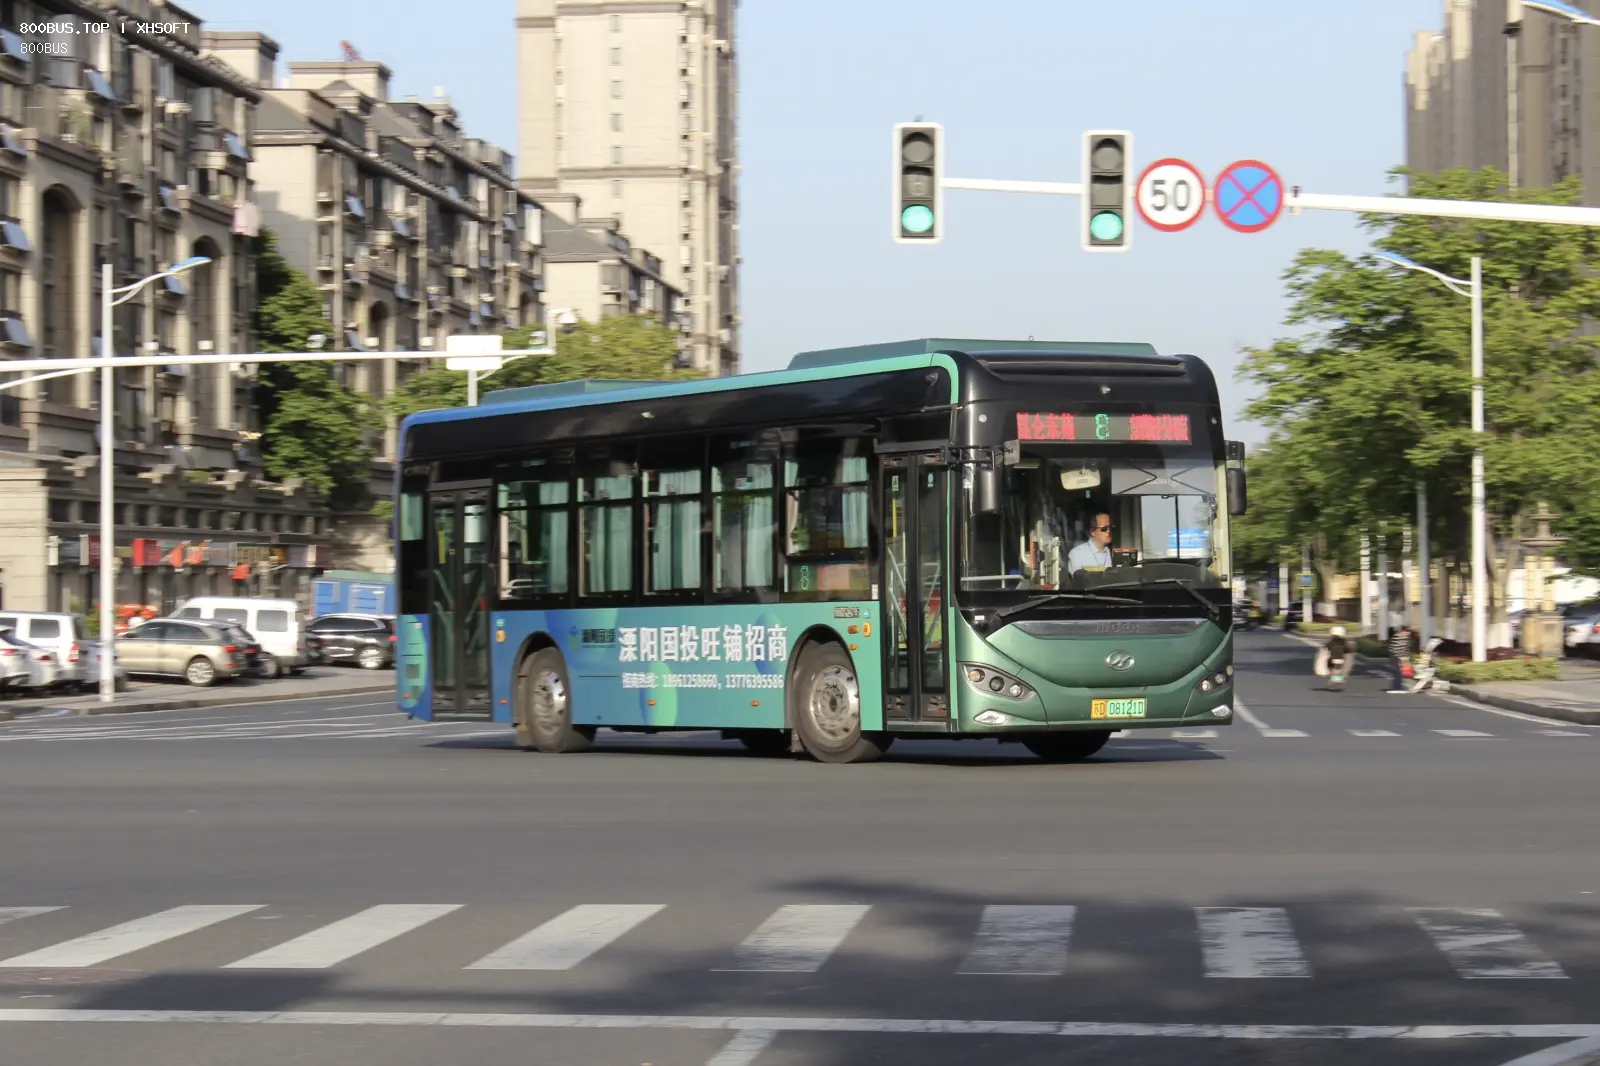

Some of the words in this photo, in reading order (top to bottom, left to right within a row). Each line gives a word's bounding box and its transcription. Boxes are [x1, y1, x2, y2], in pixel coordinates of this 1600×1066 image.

[1151, 179, 1191, 211] 50
[618, 624, 788, 663] 溧阳国投旺铺招商
